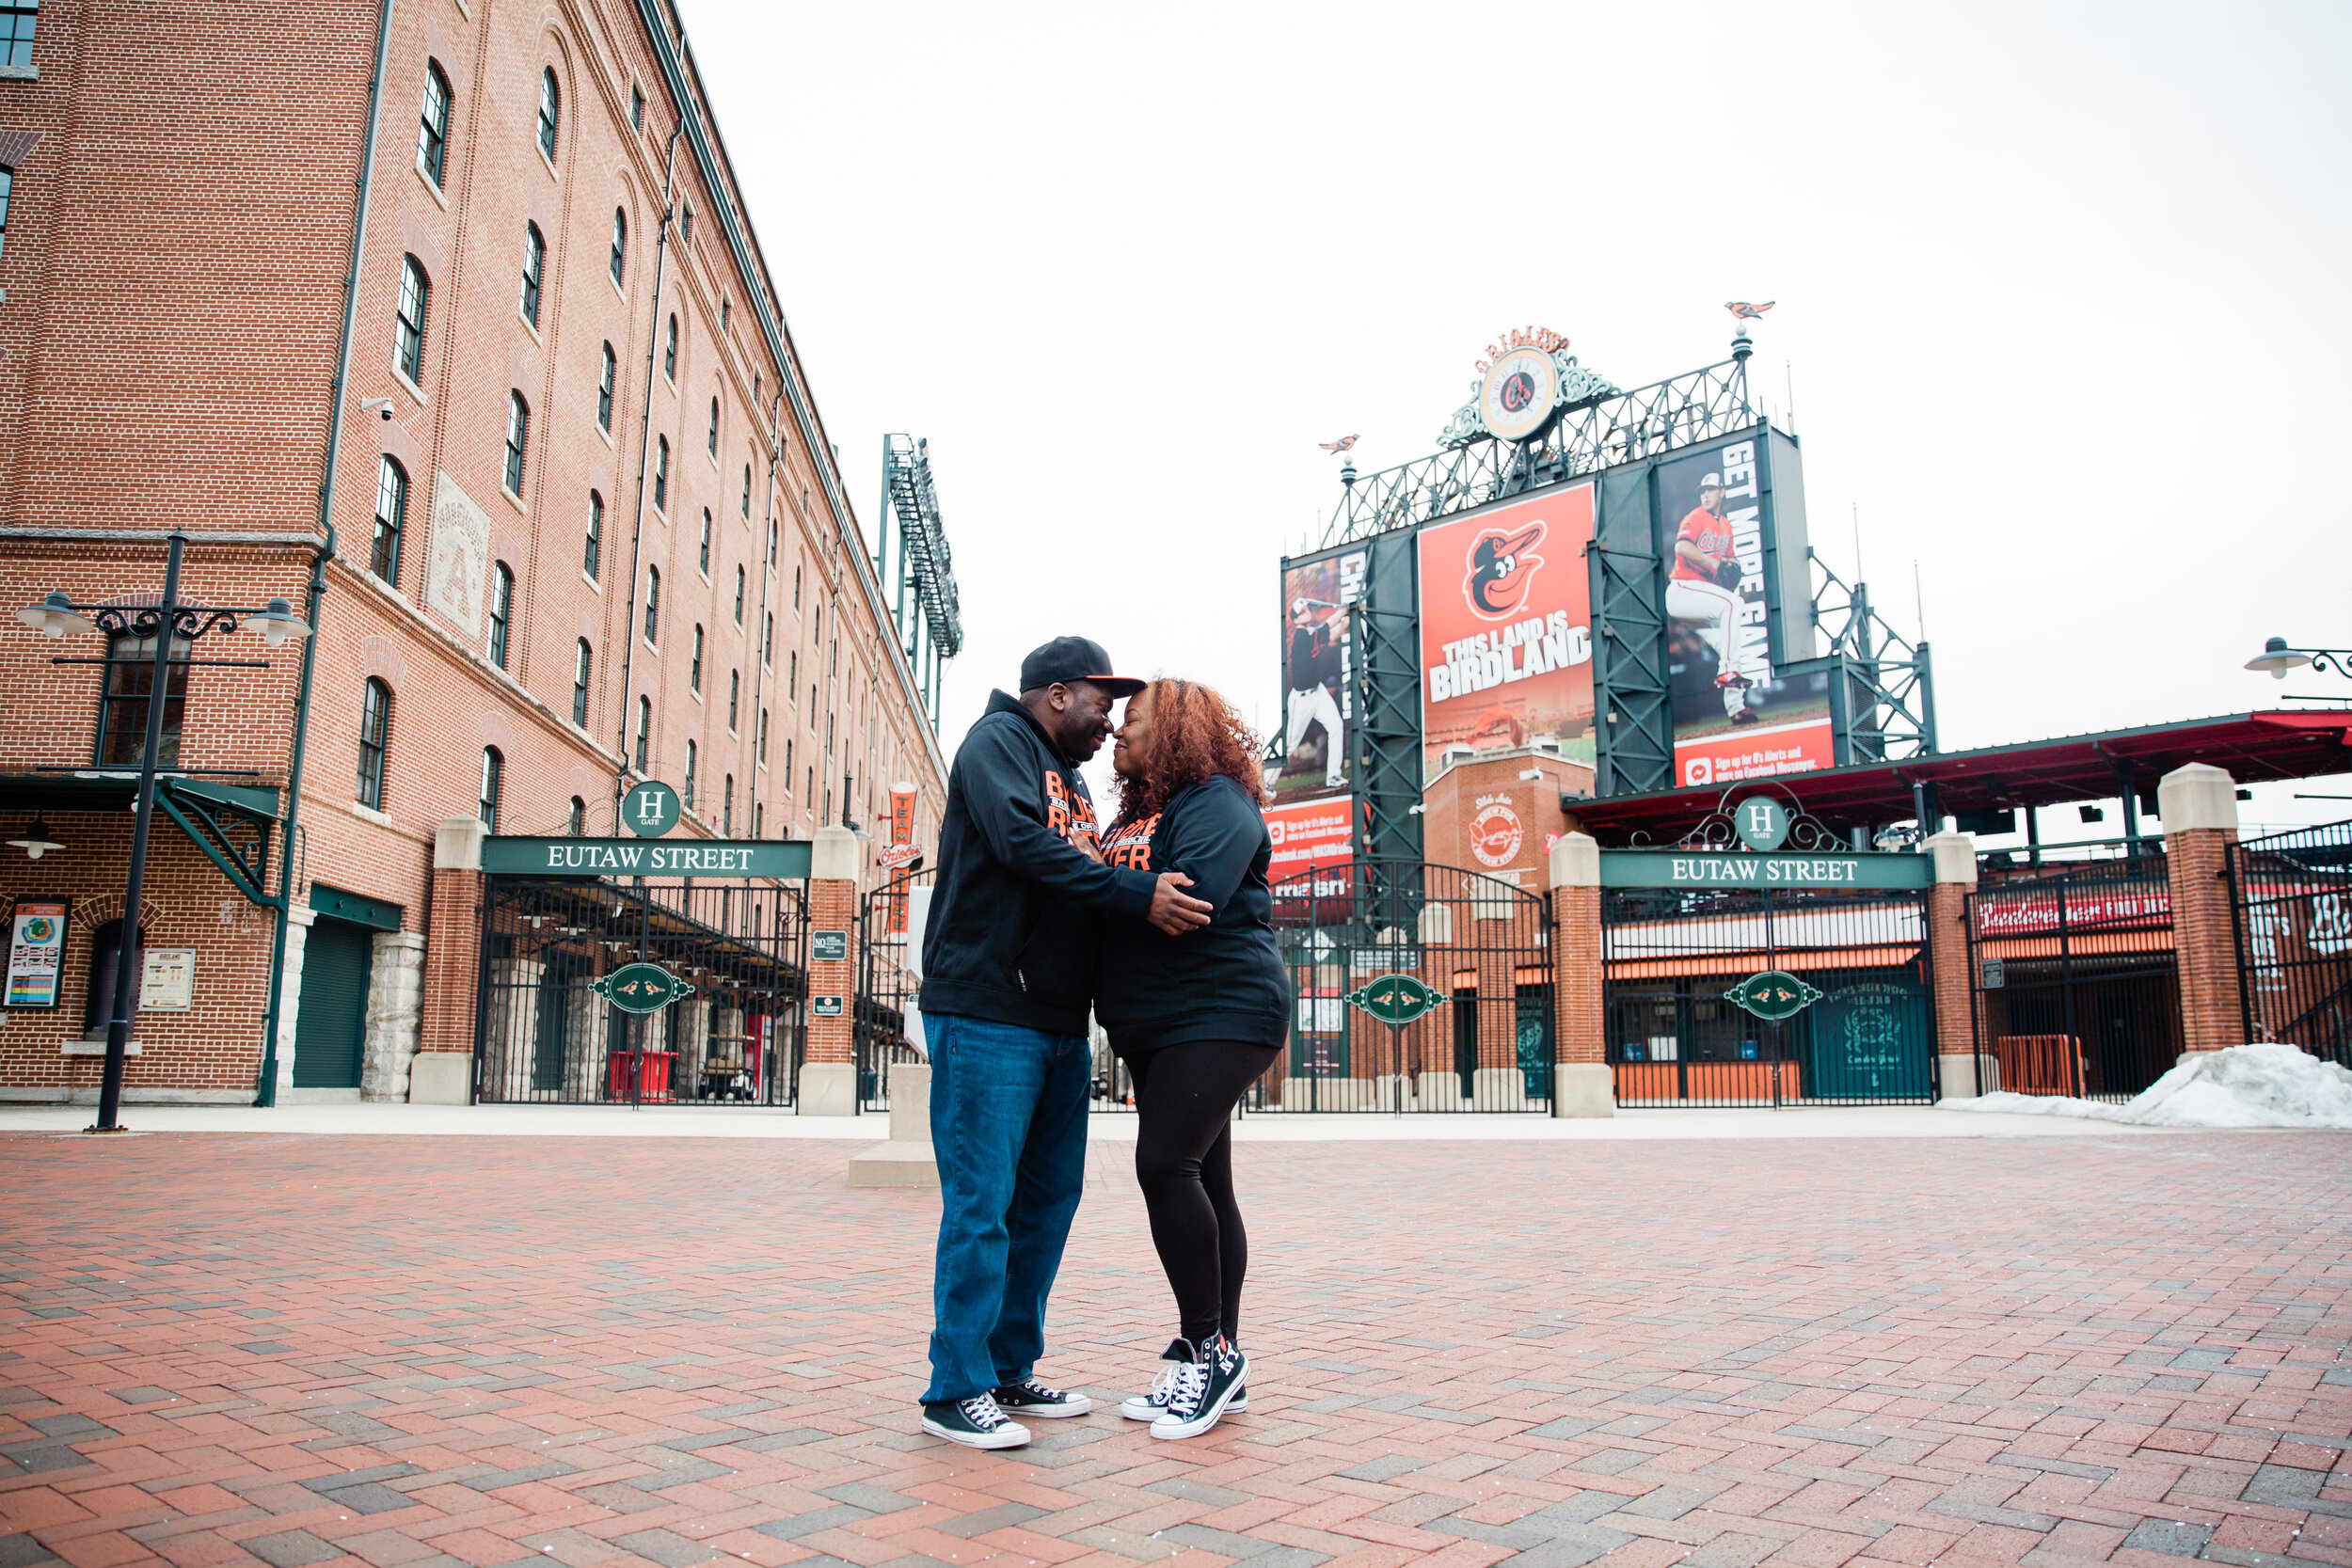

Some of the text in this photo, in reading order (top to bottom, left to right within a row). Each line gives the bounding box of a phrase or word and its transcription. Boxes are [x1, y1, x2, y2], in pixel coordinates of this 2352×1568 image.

[1474, 325, 1569, 374] ORIOLES
[1722, 440, 1772, 689] GET MORE GAME
[1442, 610, 1569, 666] THIS LAND IS
[1429, 626, 1592, 703] BIRDLAND
[1715, 746, 1802, 769] Sign up for O's Alerts and
[1715, 771, 1733, 783] more
[1734, 769, 1743, 780] on
[1744, 763, 1776, 779] Facebook
[637, 791, 665, 820] H
[896, 795, 910, 842] TEAM
[1748, 805, 1773, 832] H
[547, 846, 755, 871] EUTAW STREET
[881, 846, 922, 868] Orioles
[1671, 858, 1858, 881] EUTAW STREET
[893, 871, 907, 930] STORE
[815, 938, 826, 948] NO
[1214, 1343, 1225, 1362] I
[1218, 1339, 1240, 1377] NY
